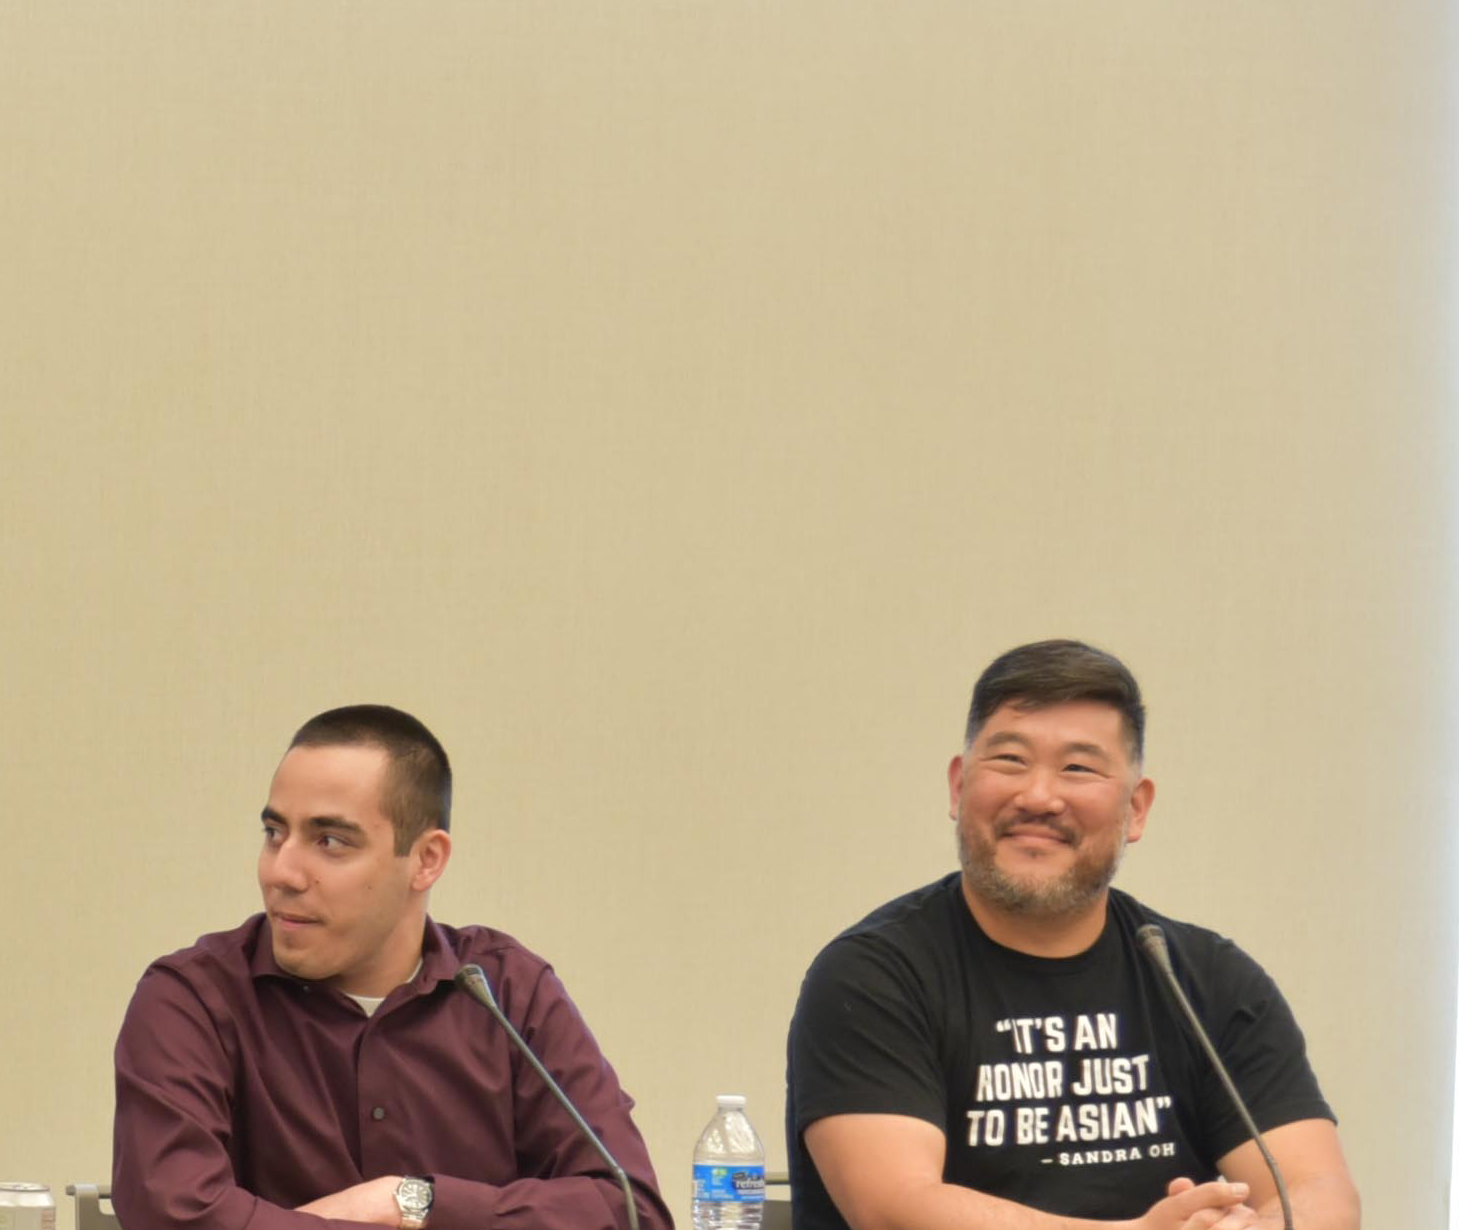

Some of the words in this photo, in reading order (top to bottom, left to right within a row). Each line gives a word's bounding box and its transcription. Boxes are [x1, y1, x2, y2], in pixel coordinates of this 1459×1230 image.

[1074, 1013, 1118, 1050] AN
[976, 1060, 1062, 1101] HONOR
[1071, 1054, 1149, 1095] JUST
[966, 1109, 1005, 1146] TO
[1016, 1107, 1049, 1145] BE
[1059, 1147, 1142, 1166] SANDRA
[1149, 1142, 1176, 1157] OH
